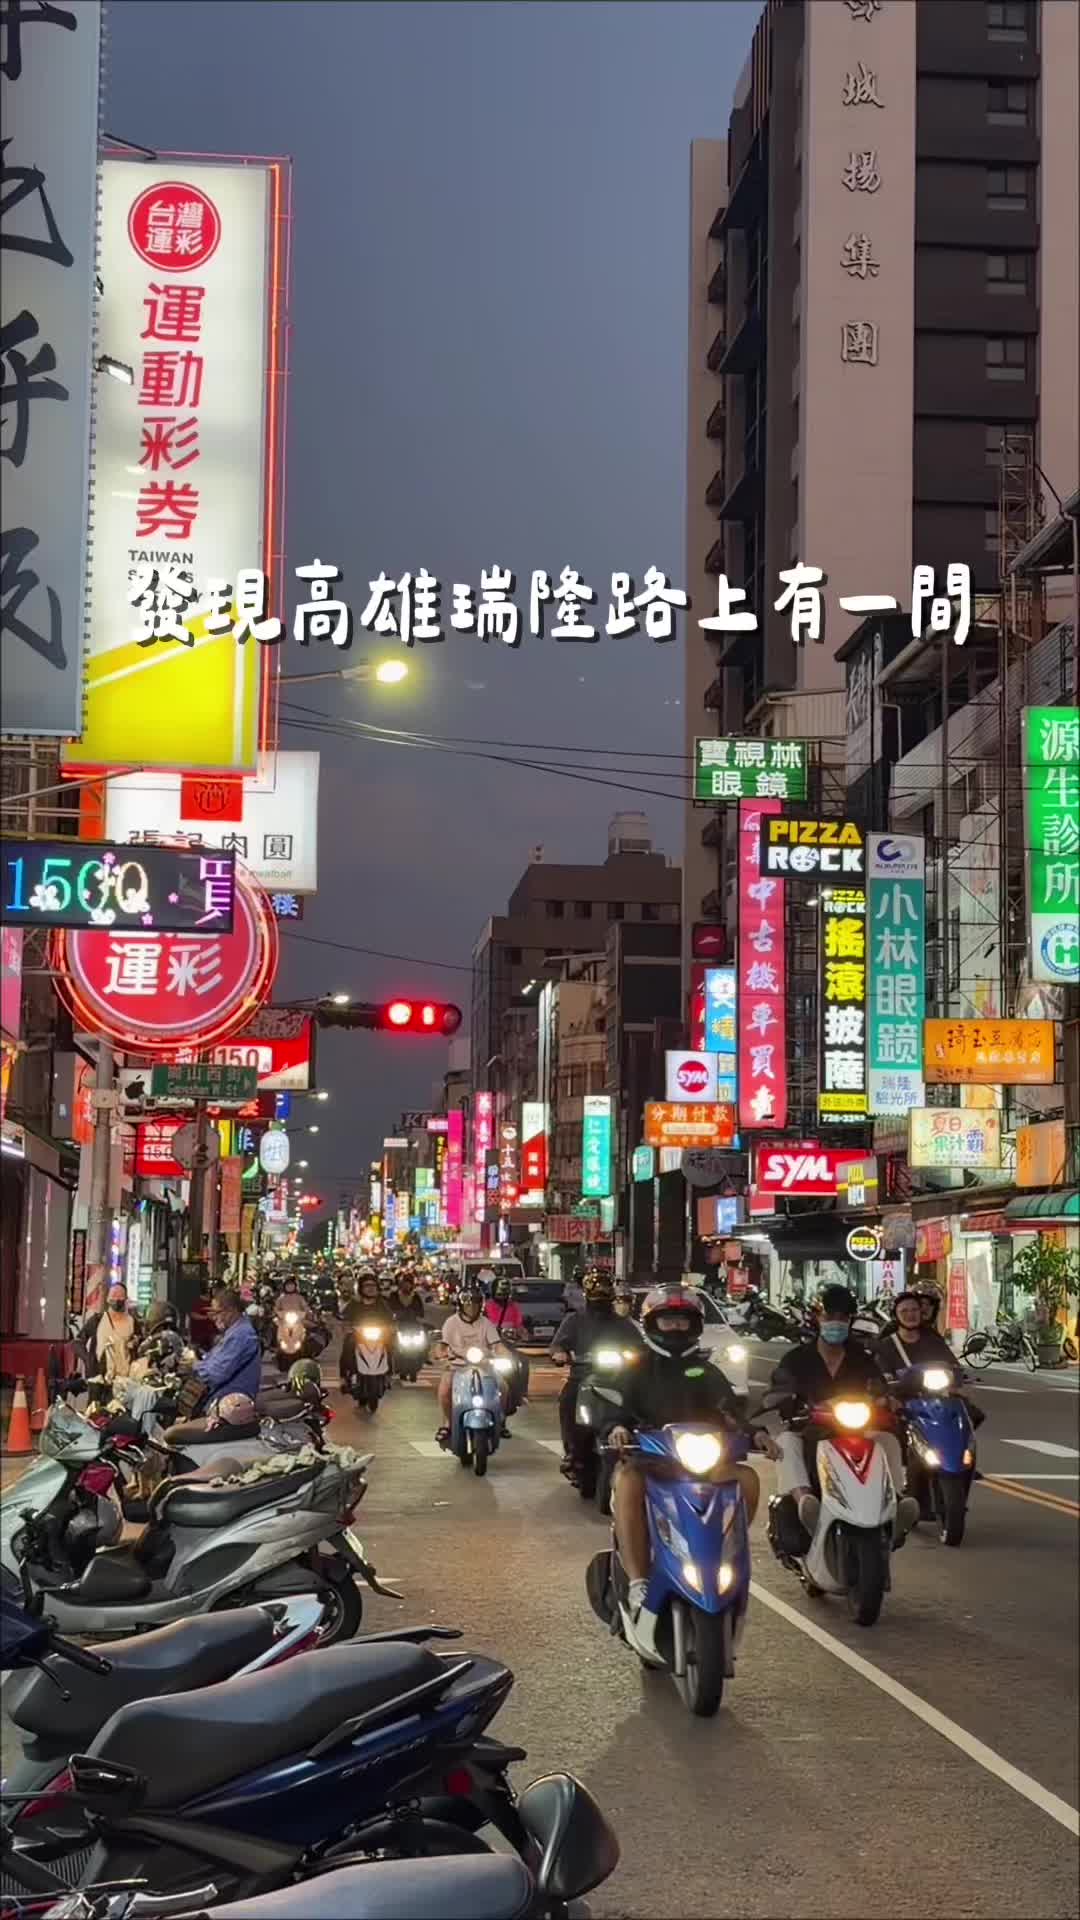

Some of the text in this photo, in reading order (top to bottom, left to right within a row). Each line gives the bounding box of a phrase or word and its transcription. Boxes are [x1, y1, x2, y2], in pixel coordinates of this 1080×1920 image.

[147, 201, 203, 225] 台灣
[145, 227, 203, 255] 運彩
[136, 282, 205, 539] 運動彩券
[128, 549, 194, 564] TAIWAN
[700, 741, 801, 769] 寶視林
[711, 771, 788, 798] 眼鏡
[1040, 718, 1080, 906] 源生診所
[769, 821, 862, 844] PIZZA
[768, 847, 862, 872] ROCK
[103, 943, 223, 997] 運彩
[875, 883, 919, 1065] 小林眼鏡
[824, 917, 865, 1091] 搖滾披薩
[677, 1069, 708, 1088] SYM
[651, 1105, 729, 1122] 分期付款
[765, 1155, 833, 1187] SYM
